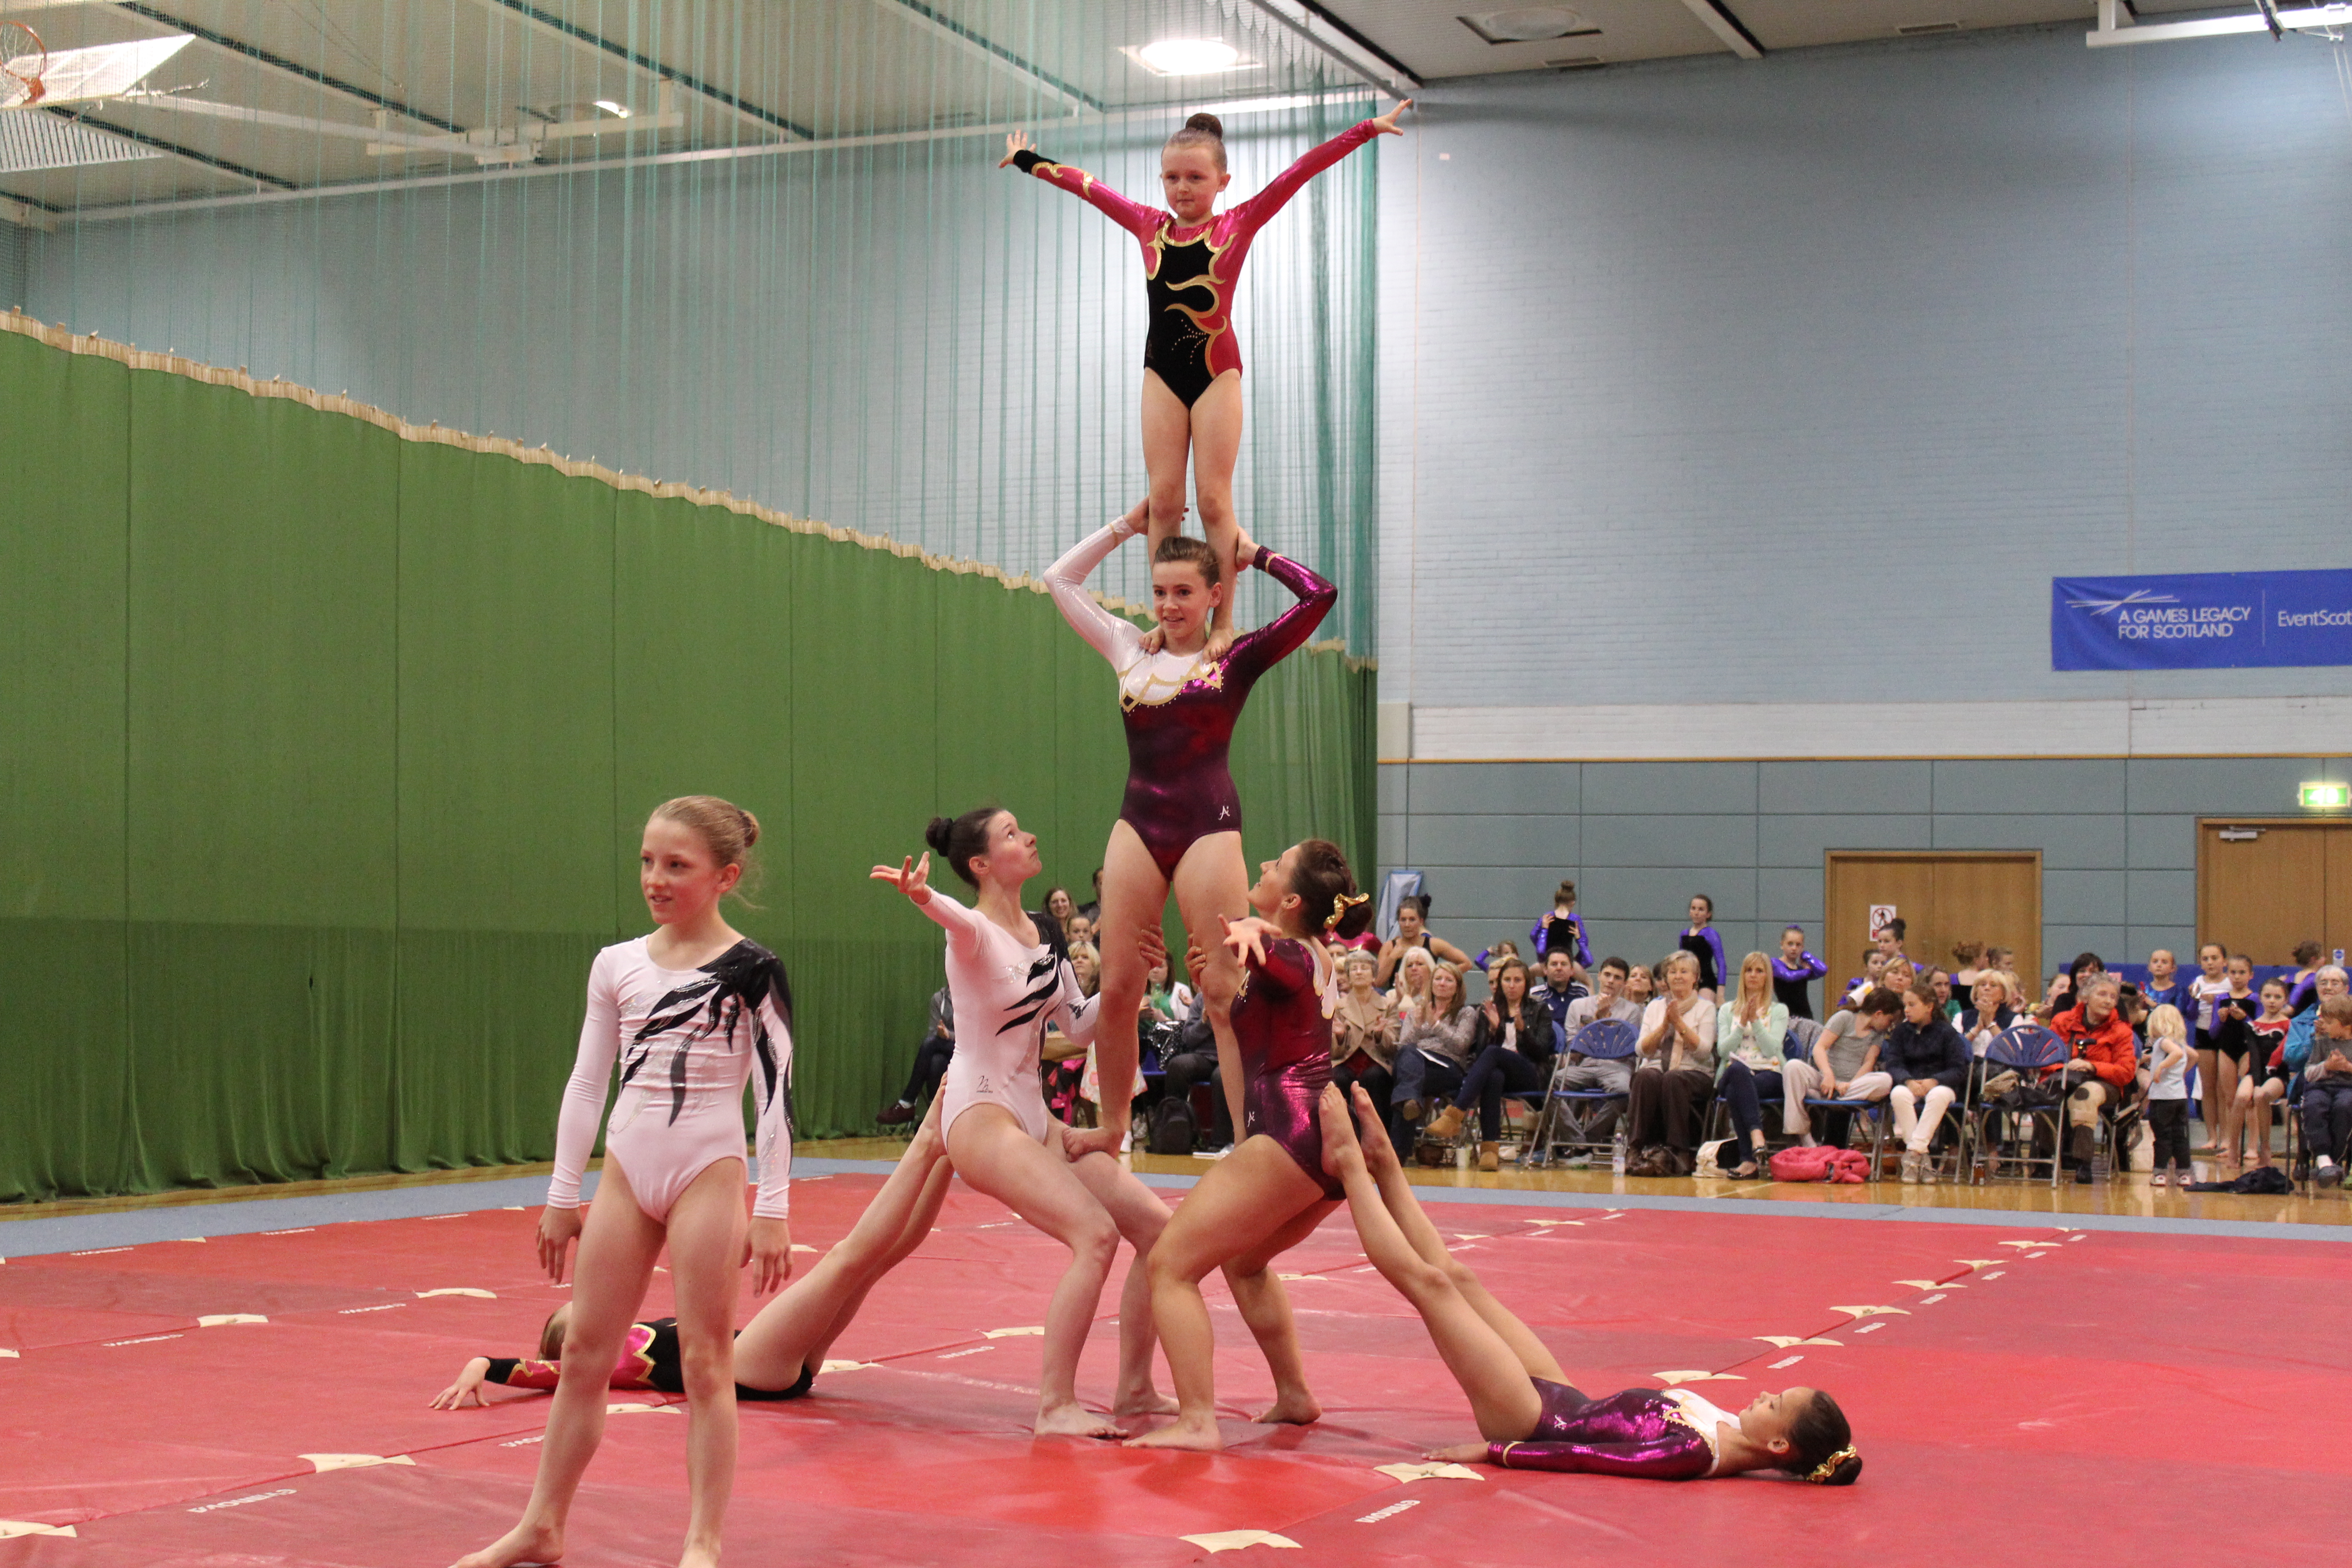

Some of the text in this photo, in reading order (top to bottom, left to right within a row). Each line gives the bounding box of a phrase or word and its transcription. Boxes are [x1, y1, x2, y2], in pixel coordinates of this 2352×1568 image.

[2118, 607, 2251, 623] A GAMES LEGACY
[2278, 609, 2352, 627] EventScot
[2118, 623, 2234, 639] FOR SCOTLAND
